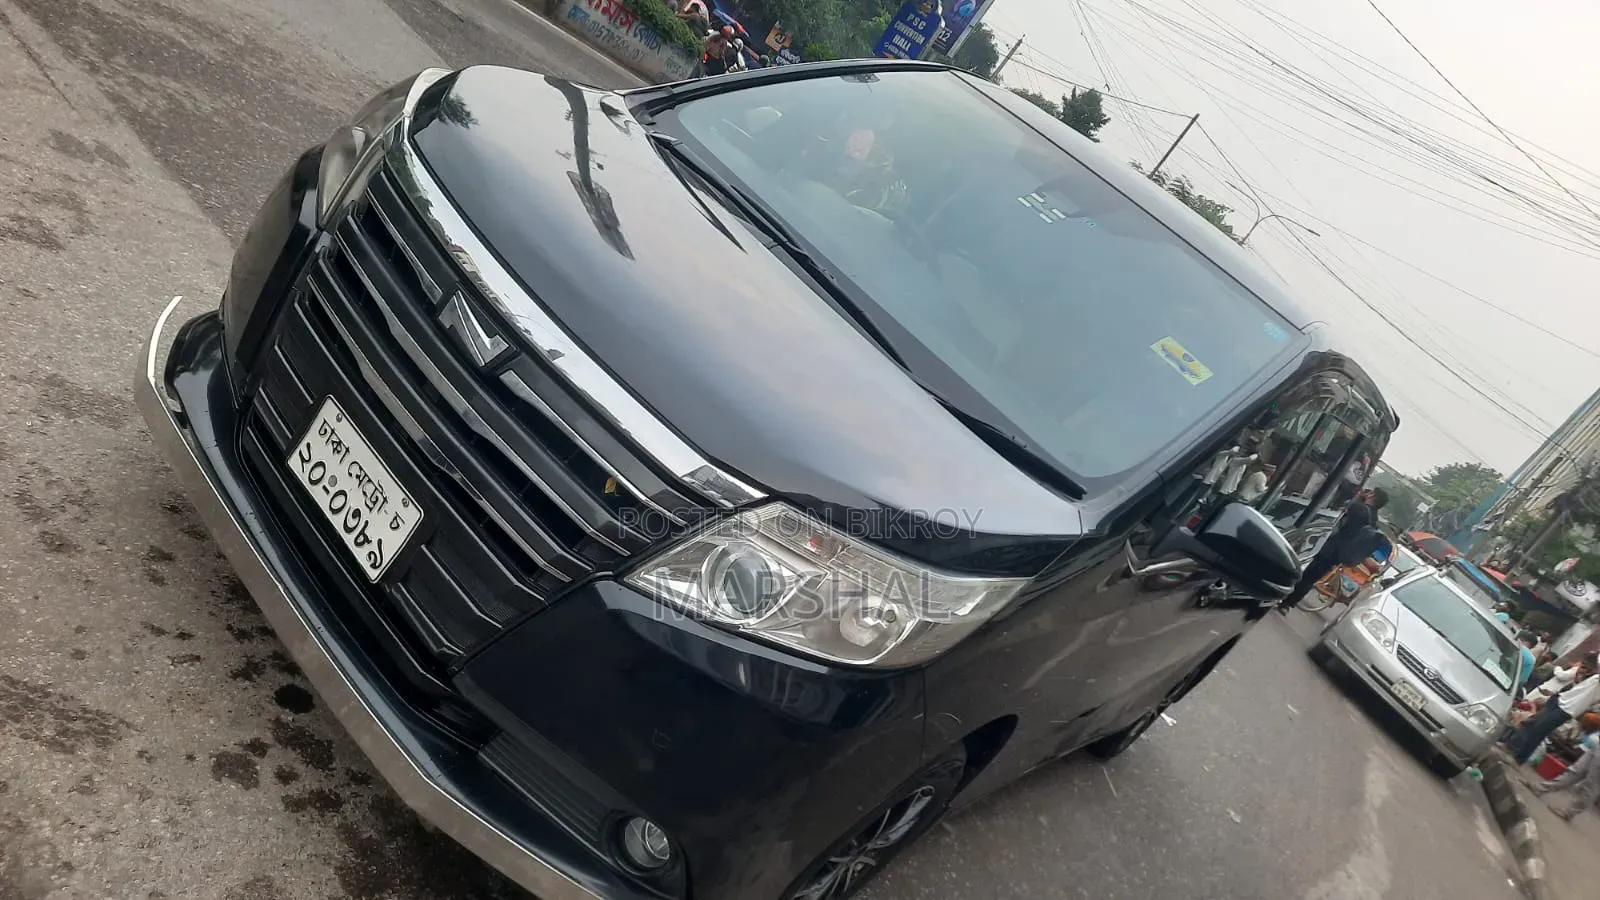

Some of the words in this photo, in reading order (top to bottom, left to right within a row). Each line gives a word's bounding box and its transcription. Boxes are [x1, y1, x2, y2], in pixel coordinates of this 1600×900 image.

[893, 20, 926, 45] CONVENTION
[906, 13, 926, 30] PSC
[892, 34, 912, 52] HALL
[318, 418, 350, 464] ঢাকা
[389, 511, 406, 532] চ
[298, 442, 385, 570] ২০-০৩৮৯
